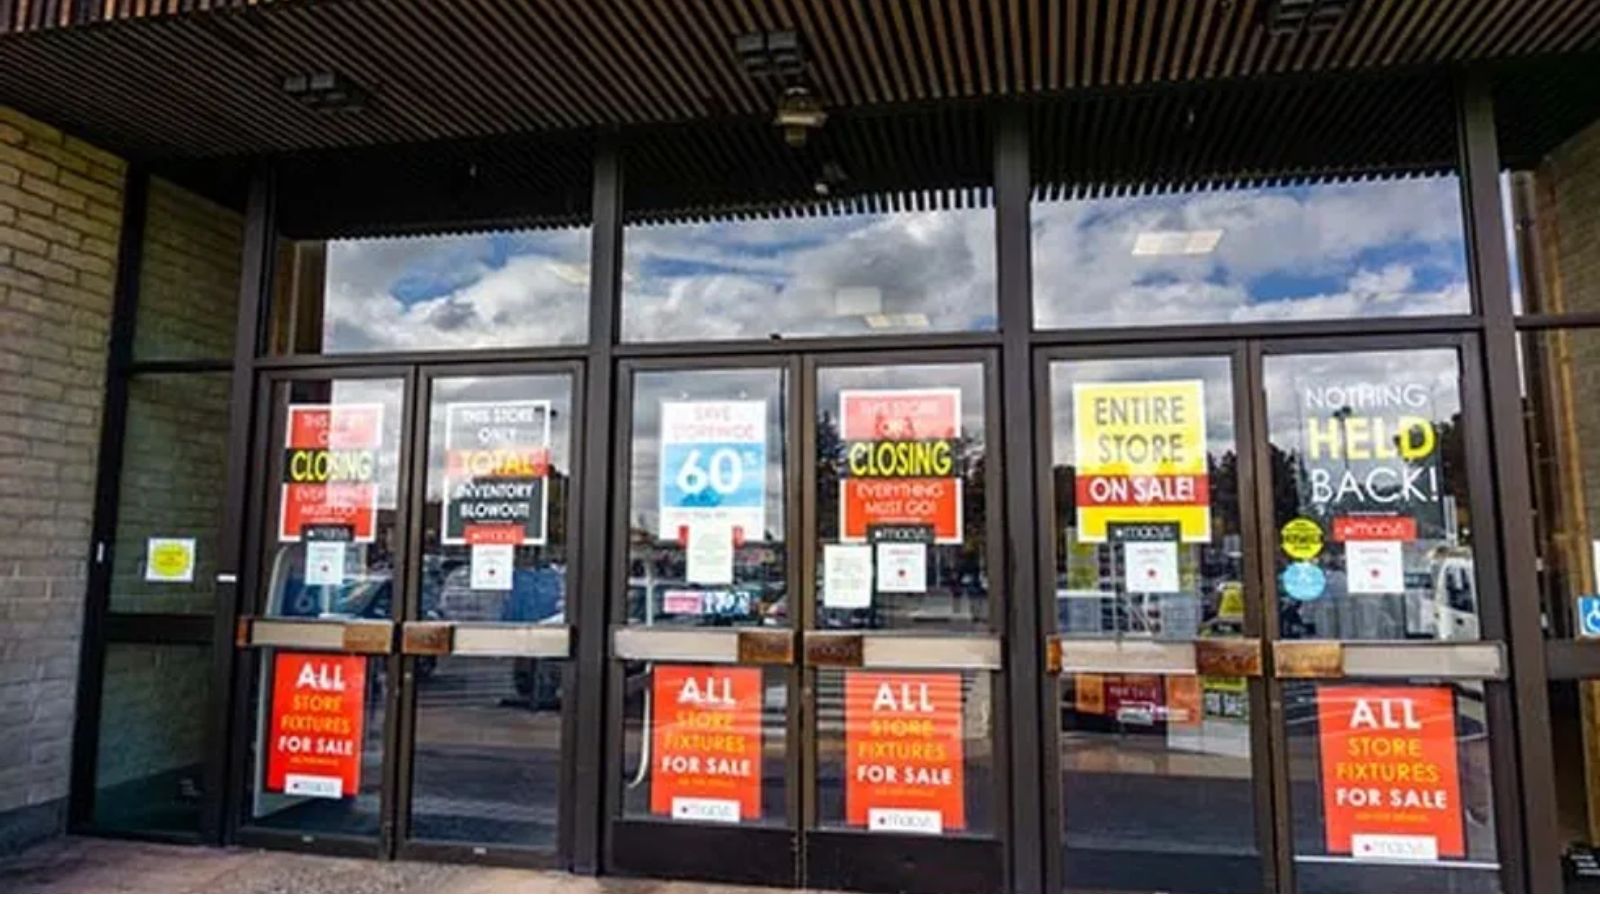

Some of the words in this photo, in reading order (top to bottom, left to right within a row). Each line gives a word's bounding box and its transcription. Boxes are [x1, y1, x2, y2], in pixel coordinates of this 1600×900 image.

[1306, 384, 1427, 408] NOTHING
[463, 409, 490, 423] THIS
[494, 407, 534, 423] STORE
[1094, 396, 1185, 425] ENTIRE
[1307, 415, 1437, 460] HELD
[849, 441, 952, 476] CLOSING
[1098, 434, 1184, 464] STORE
[291, 450, 371, 481] CLOSING
[461, 449, 536, 476] TOTAL
[456, 483, 533, 499] INVENTORY
[857, 481, 944, 499] EVERYTHING
[1089, 477, 1127, 502] ON
[1132, 476, 1195, 502] SALE!
[1311, 466, 1439, 502] BACK!
[864, 501, 902, 516] MUST
[296, 661, 345, 691] ALL
[676, 676, 736, 705] ALL
[872, 681, 935, 712] ALL
[292, 693, 343, 712] STORE
[1350, 697, 1422, 730] ALL
[280, 715, 352, 734] FIXTURES
[675, 711, 735, 731] STORE
[869, 718, 935, 737] STORE
[277, 735, 312, 753] FOR
[316, 737, 354, 756] SALE
[663, 733, 746, 753] FIXTURES
[857, 741, 948, 763] FIXTURES
[1347, 736, 1422, 757] STORE
[661, 755, 700, 774] FOR
[705, 756, 752, 776] SALE
[856, 764, 897, 784] FOR
[903, 766, 952, 785] SALE
[1335, 761, 1440, 783] FIXTURES
[1335, 787, 1381, 807] FOR
[1389, 788, 1447, 809] SALE
